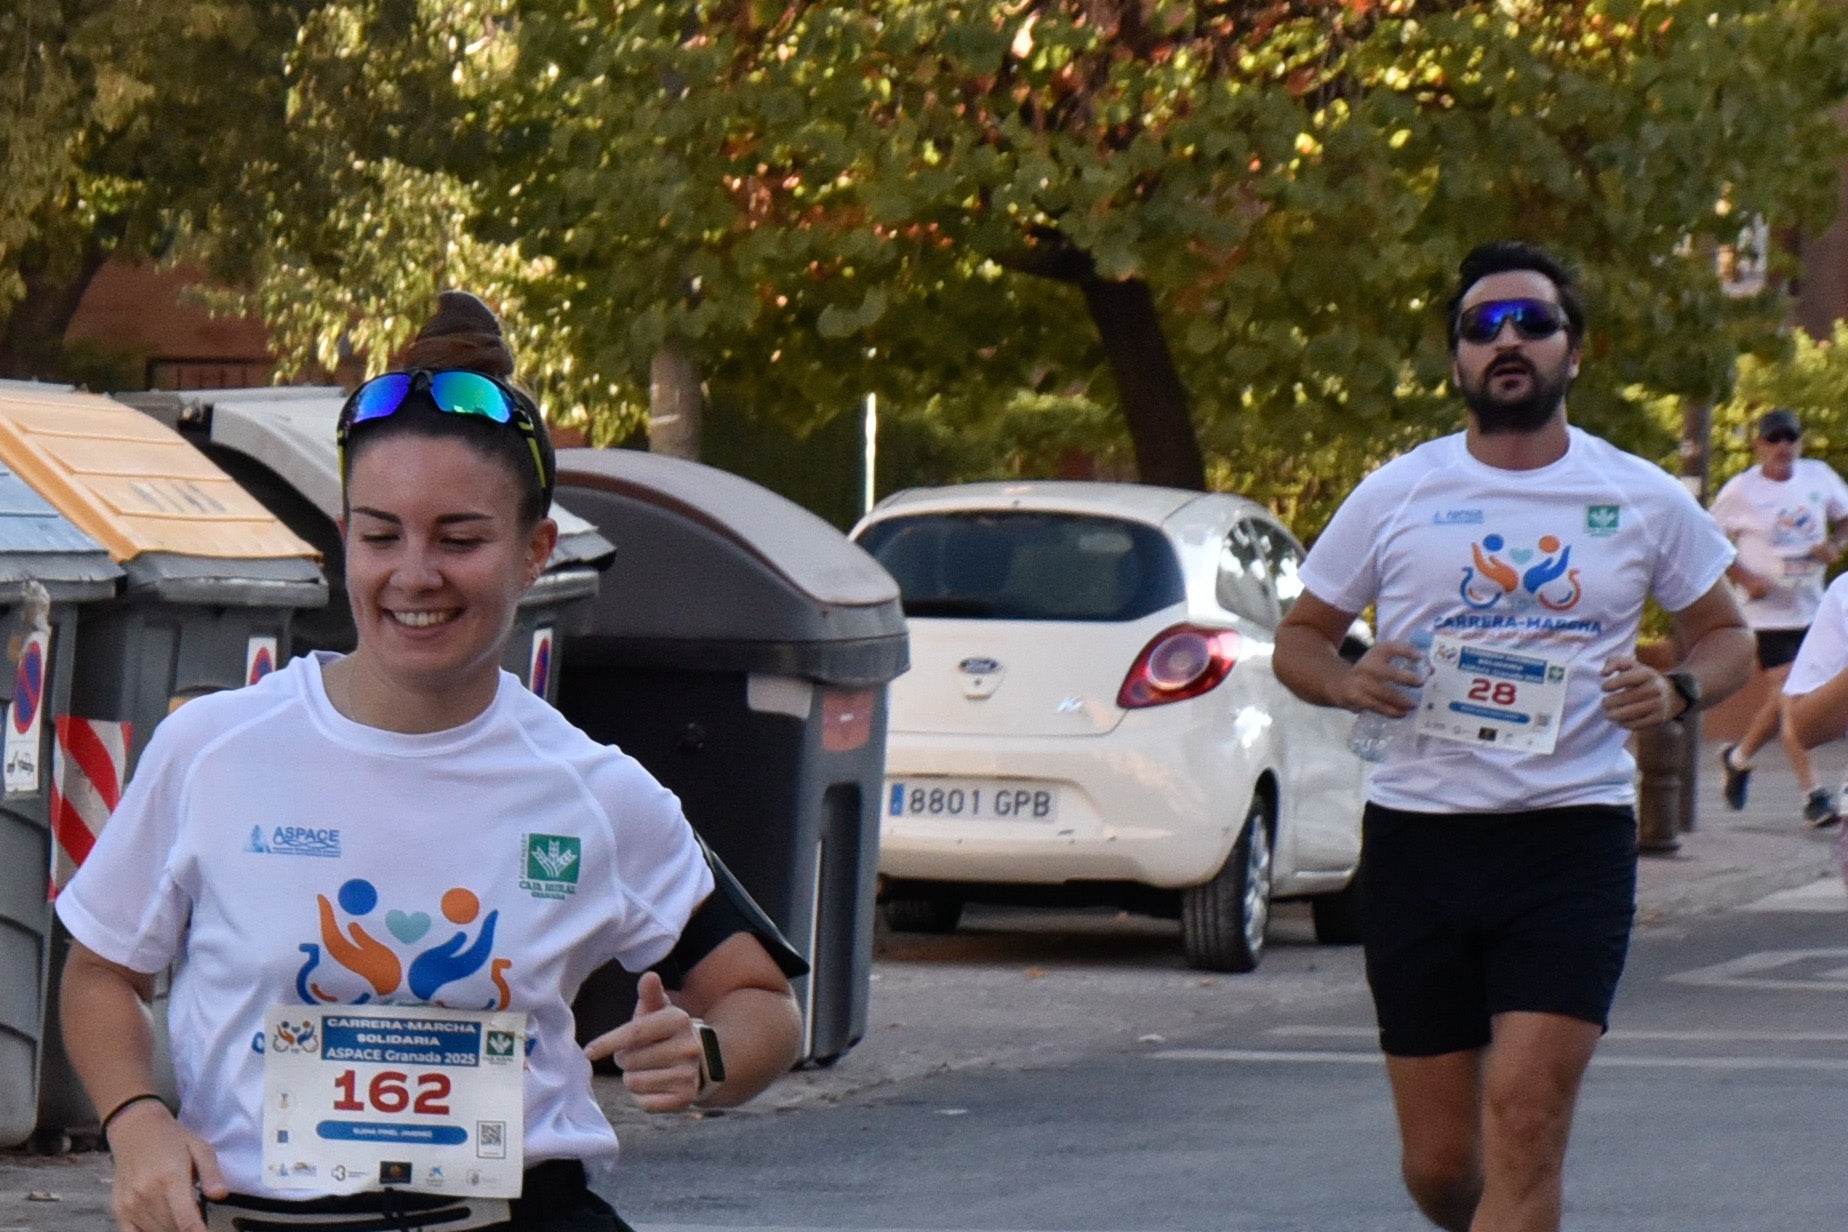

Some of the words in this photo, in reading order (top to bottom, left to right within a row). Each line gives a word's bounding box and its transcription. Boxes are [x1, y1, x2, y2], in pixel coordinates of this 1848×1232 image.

[1467, 677, 1518, 706] 28
[910, 787, 980, 816] 8801
[994, 789, 1051, 817] GPB
[272, 825, 340, 846] ASPACE
[327, 1018, 476, 1034] CARRERA-MARCHA
[356, 1034, 441, 1047] SOLIDARIA
[326, 1047, 382, 1062] ASPACE
[384, 1047, 442, 1064] Granada
[444, 1050, 477, 1065] 2025
[333, 1068, 452, 1116] 162
